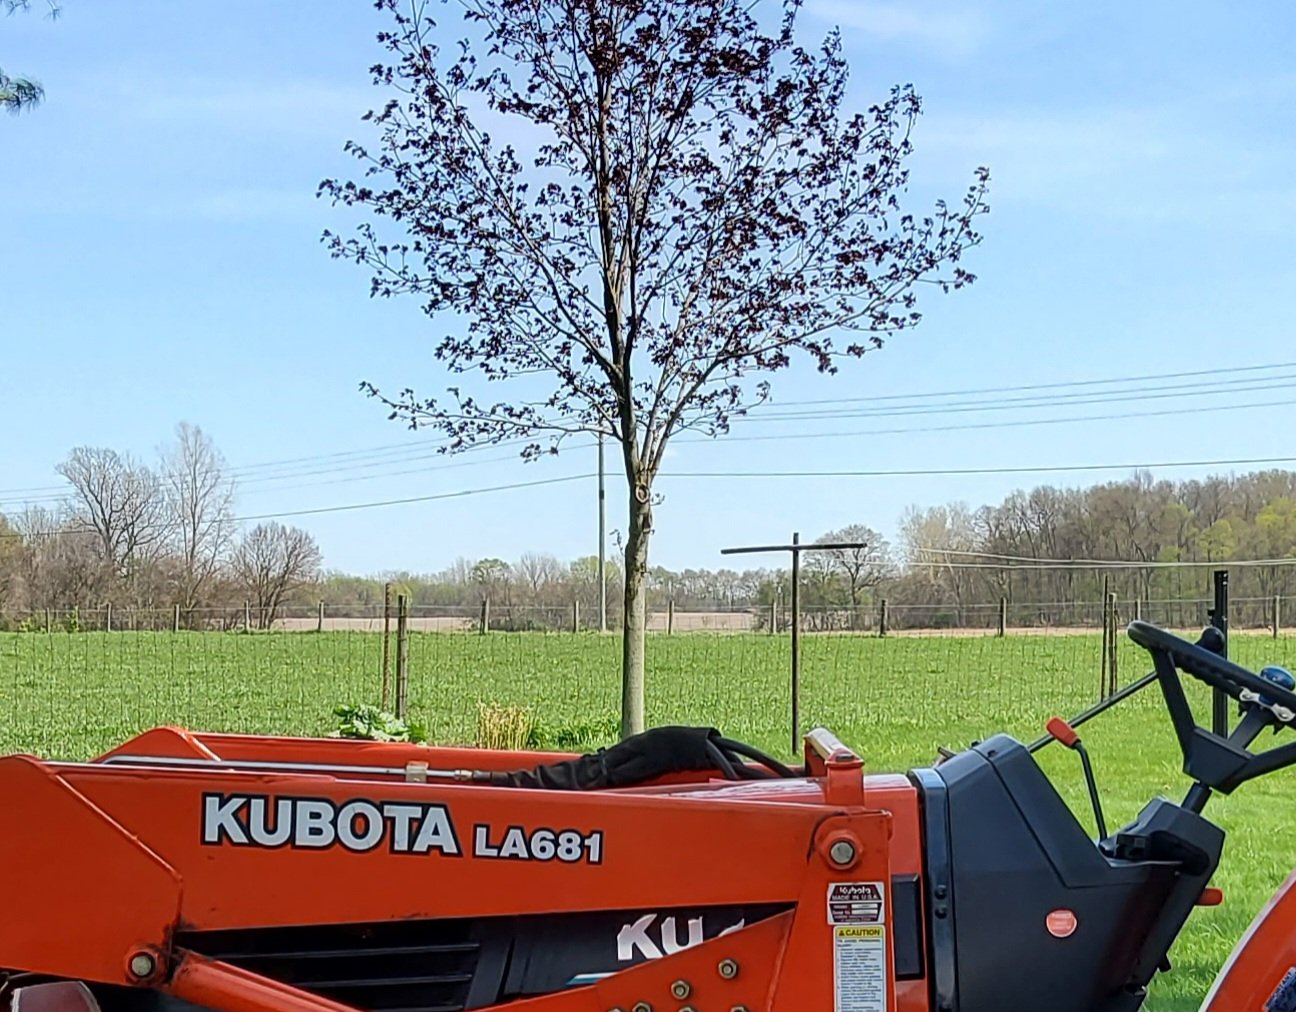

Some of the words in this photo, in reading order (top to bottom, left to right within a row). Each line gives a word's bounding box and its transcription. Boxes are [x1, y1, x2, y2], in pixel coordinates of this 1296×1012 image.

[204, 796, 460, 855] KUBOTA
[474, 826, 601, 863] LA681
[839, 886, 872, 895] Kubota
[845, 928, 881, 936] CAUTION
